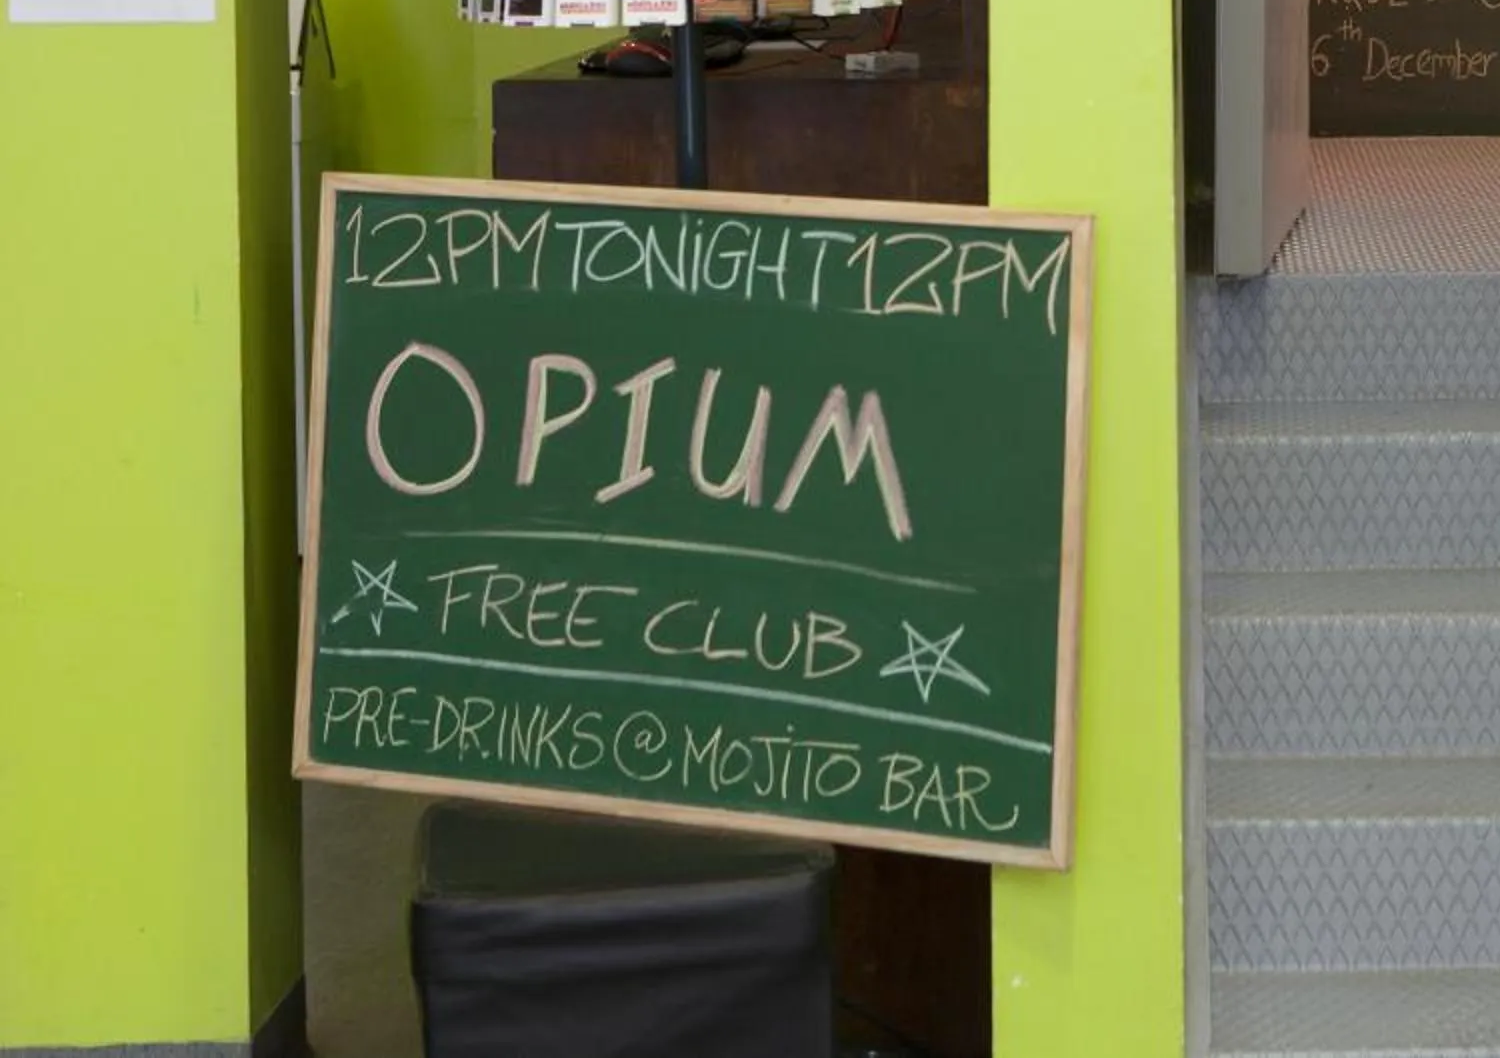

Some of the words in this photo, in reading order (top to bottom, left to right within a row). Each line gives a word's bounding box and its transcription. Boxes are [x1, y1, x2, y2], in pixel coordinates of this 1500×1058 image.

[1362, 38, 1499, 82] December
[345, 205, 551, 291] 12PM
[848, 231, 1070, 334] 12PM
[365, 341, 912, 540] OPIUM
[428, 563, 639, 650] FREE
[643, 599, 863, 680] CLUB
[878, 753, 1019, 831] BAR
